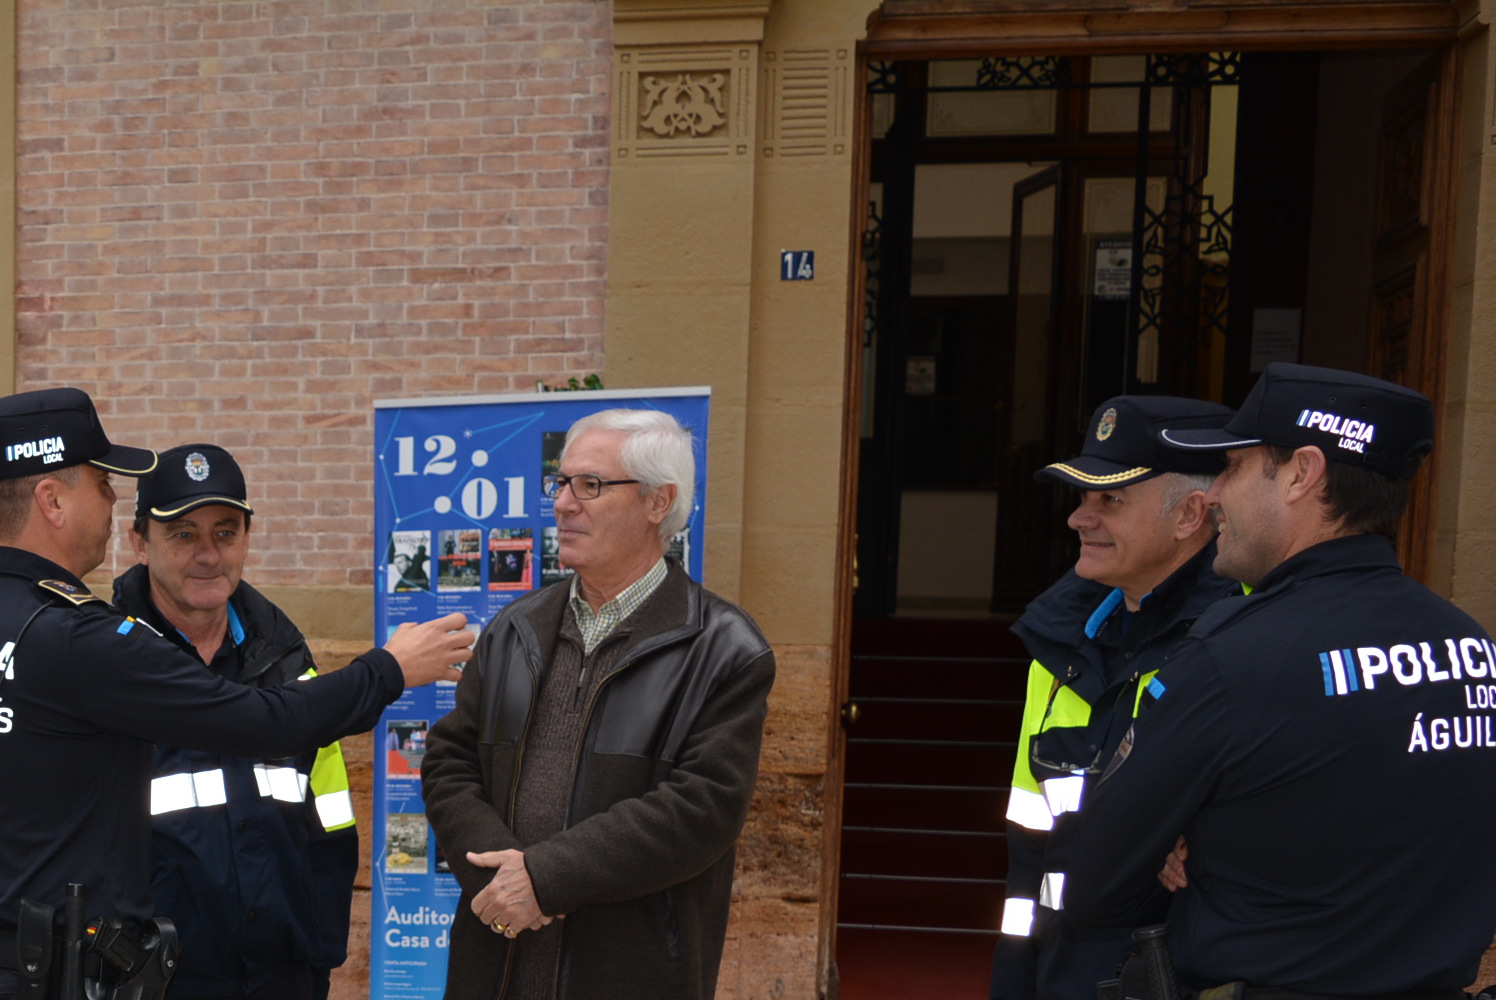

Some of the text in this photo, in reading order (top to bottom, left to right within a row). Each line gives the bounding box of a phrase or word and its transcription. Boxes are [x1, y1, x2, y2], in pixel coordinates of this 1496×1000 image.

[784, 252, 813, 279] 14
[1306, 411, 1375, 443] POLICIA
[14, 436, 65, 460] POLICIA
[1338, 437, 1364, 453] LOCAL
[43, 453, 64, 464] LOCAL
[1357, 637, 1496, 690] POLICI
[385, 928, 451, 948] Casa d
